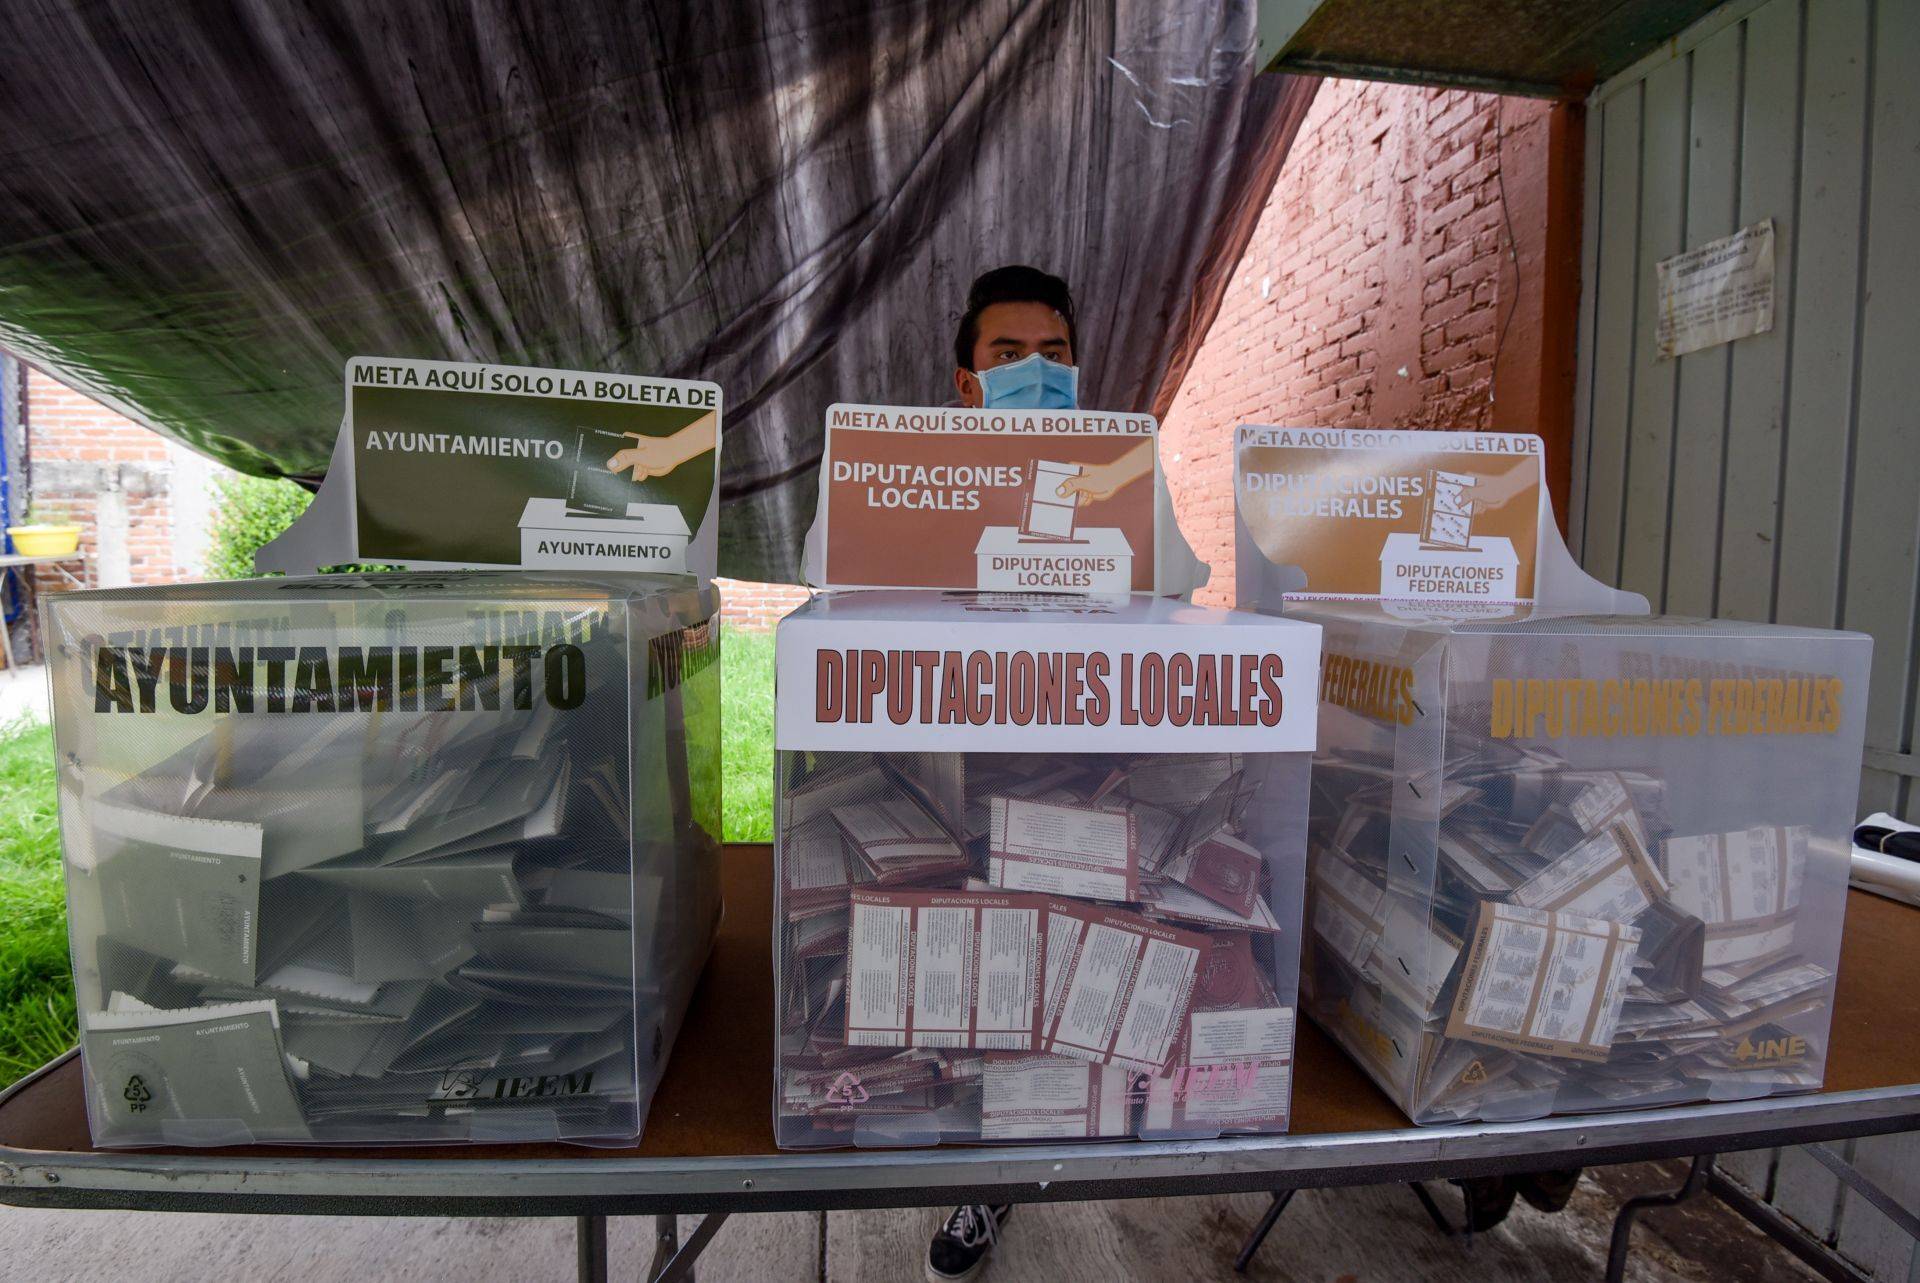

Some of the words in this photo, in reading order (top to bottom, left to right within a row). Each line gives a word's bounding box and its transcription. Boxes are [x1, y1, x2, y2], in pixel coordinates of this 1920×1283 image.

[354, 365, 419, 386] META
[425, 367, 485, 391] AQUÍ
[491, 373, 553, 395] SOLO
[559, 378, 588, 398] LA
[594, 381, 681, 405] BOLETA
[688, 388, 716, 407] DE
[832, 411, 889, 429] META
[895, 411, 947, 433] AQUÍ
[952, 416, 1006, 432] SOLO
[1012, 417, 1037, 432] LA
[1042, 418, 1120, 433] BOLETA
[1126, 420, 1152, 434] DE
[366, 430, 564, 460] AYUNTAMIENTO
[1240, 429, 1291, 446] META
[1298, 429, 1346, 449] AQUÍ
[1514, 438, 1538, 453] DE
[833, 461, 1023, 487] DIPUTACIONES
[1246, 472, 1424, 497] DIPUTACIONES
[867, 487, 981, 511] LOCALES
[1270, 498, 1403, 519] FEDERALES
[537, 540, 671, 560] AYUNTAMIENTO
[992, 557, 1115, 572] DIPUTACIONES
[1396, 564, 1504, 580] DIPUTACIONES
[1017, 573, 1091, 587] LOCALES
[1409, 579, 1490, 594] FEDERALES
[94, 643, 587, 715] AYUNTAMIENTO
[816, 649, 1111, 727] DIPUTACIONES
[1120, 652, 1284, 727] LOCALES
[1321, 653, 1414, 727] FEDERALES
[1490, 678, 1704, 738] DIPUTACIONES
[1706, 678, 1844, 736] FEDERALES
[170, 852, 222, 865] AYUNTAMIENTO
[862, 896, 891, 904] LOCALES
[931, 897, 979, 905] DIPUTACIONES
[980, 898, 1010, 906] LOCALES
[243, 910, 251, 965] AYUNTAMIENTO
[1103, 916, 1152, 935] DIPUTACIONES
[1149, 927, 1176, 940] LOCALES
[908, 931, 916, 978] DIPUTACIONES
[972, 931, 981, 978] DIPUTACIONES
[1034, 932, 1043, 979] DIPUTACIONES
[971, 979, 979, 1007] LOCALES
[196, 1023, 249, 1036] AYUNTAMIENTO
[1756, 1036, 1807, 1060] INE
[133, 1085, 141, 1097] 5
[494, 1071, 595, 1098] IEEM
[842, 1085, 854, 1097] 5
[130, 1103, 147, 1113] PP
